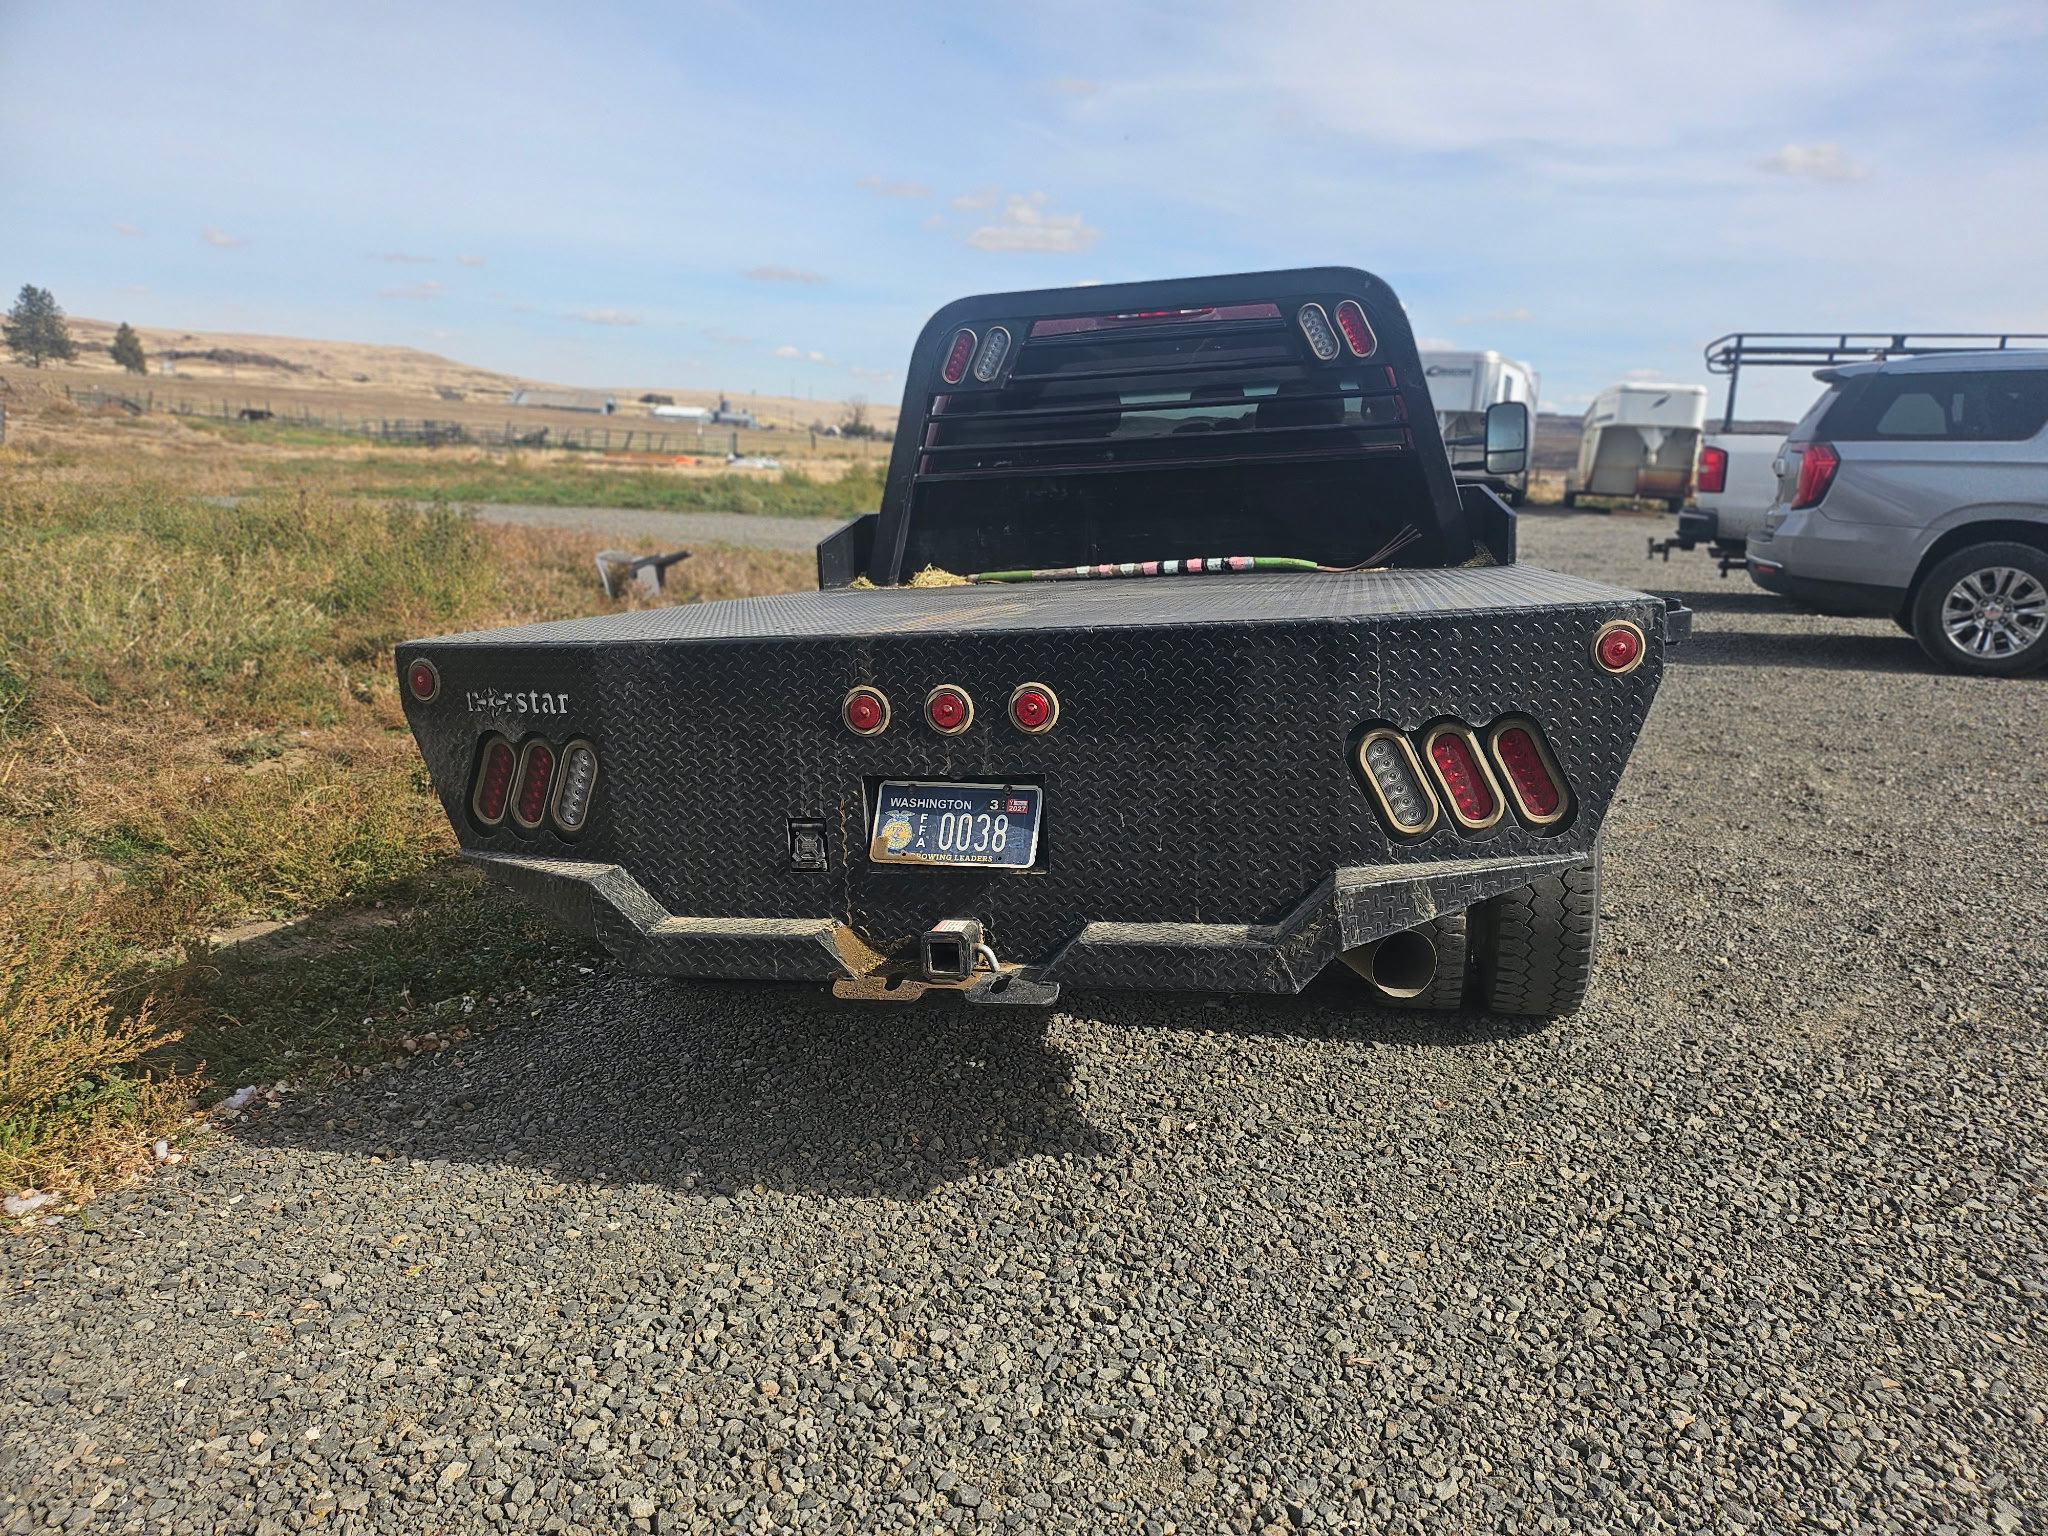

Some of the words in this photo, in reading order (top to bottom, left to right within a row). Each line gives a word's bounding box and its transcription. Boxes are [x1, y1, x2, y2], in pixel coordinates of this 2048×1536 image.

[890, 797, 972, 810] WASHINGTON
[989, 799, 999, 810] 3
[938, 812, 1009, 852] 0038
[954, 854, 993, 862] LEADERS
